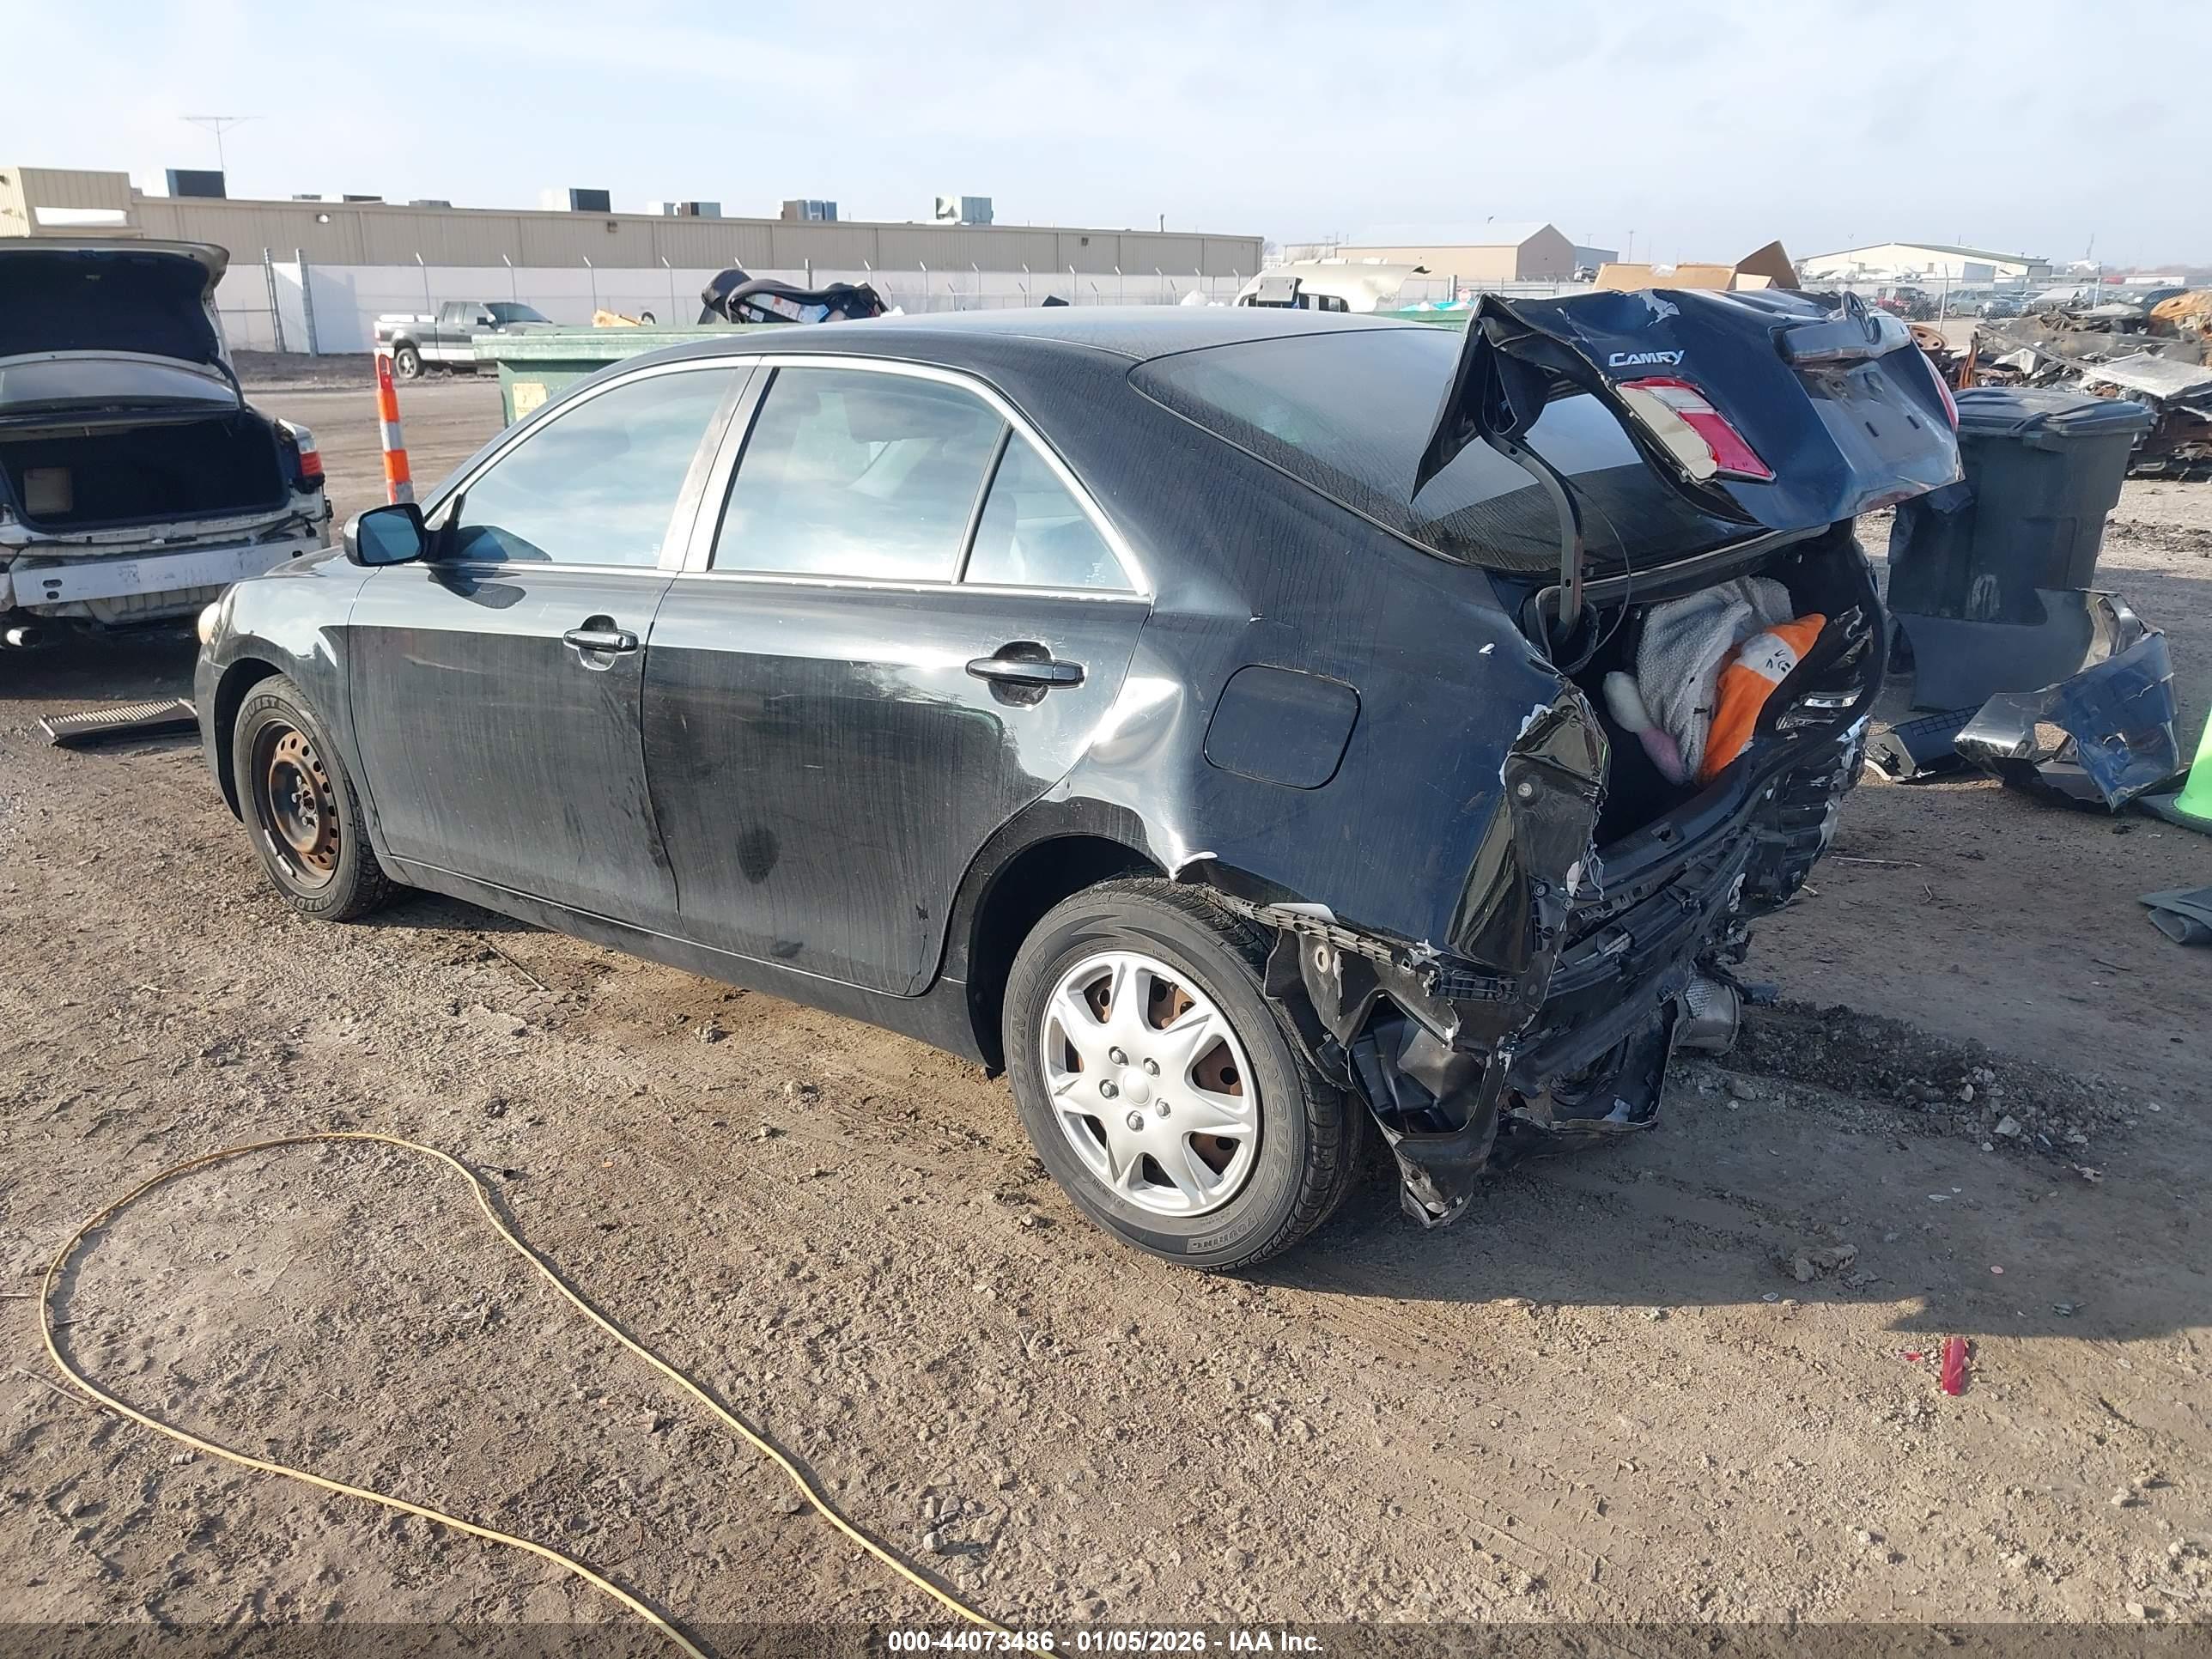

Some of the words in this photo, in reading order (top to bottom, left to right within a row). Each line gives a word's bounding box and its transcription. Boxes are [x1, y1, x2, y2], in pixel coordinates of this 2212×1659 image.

[1607, 349, 1686, 368] CAMRY
[286, 887, 337, 911] DUNLOP
[1011, 946, 1048, 1091] DUNLOP
[1192, 1213, 1257, 1250] TOURING
